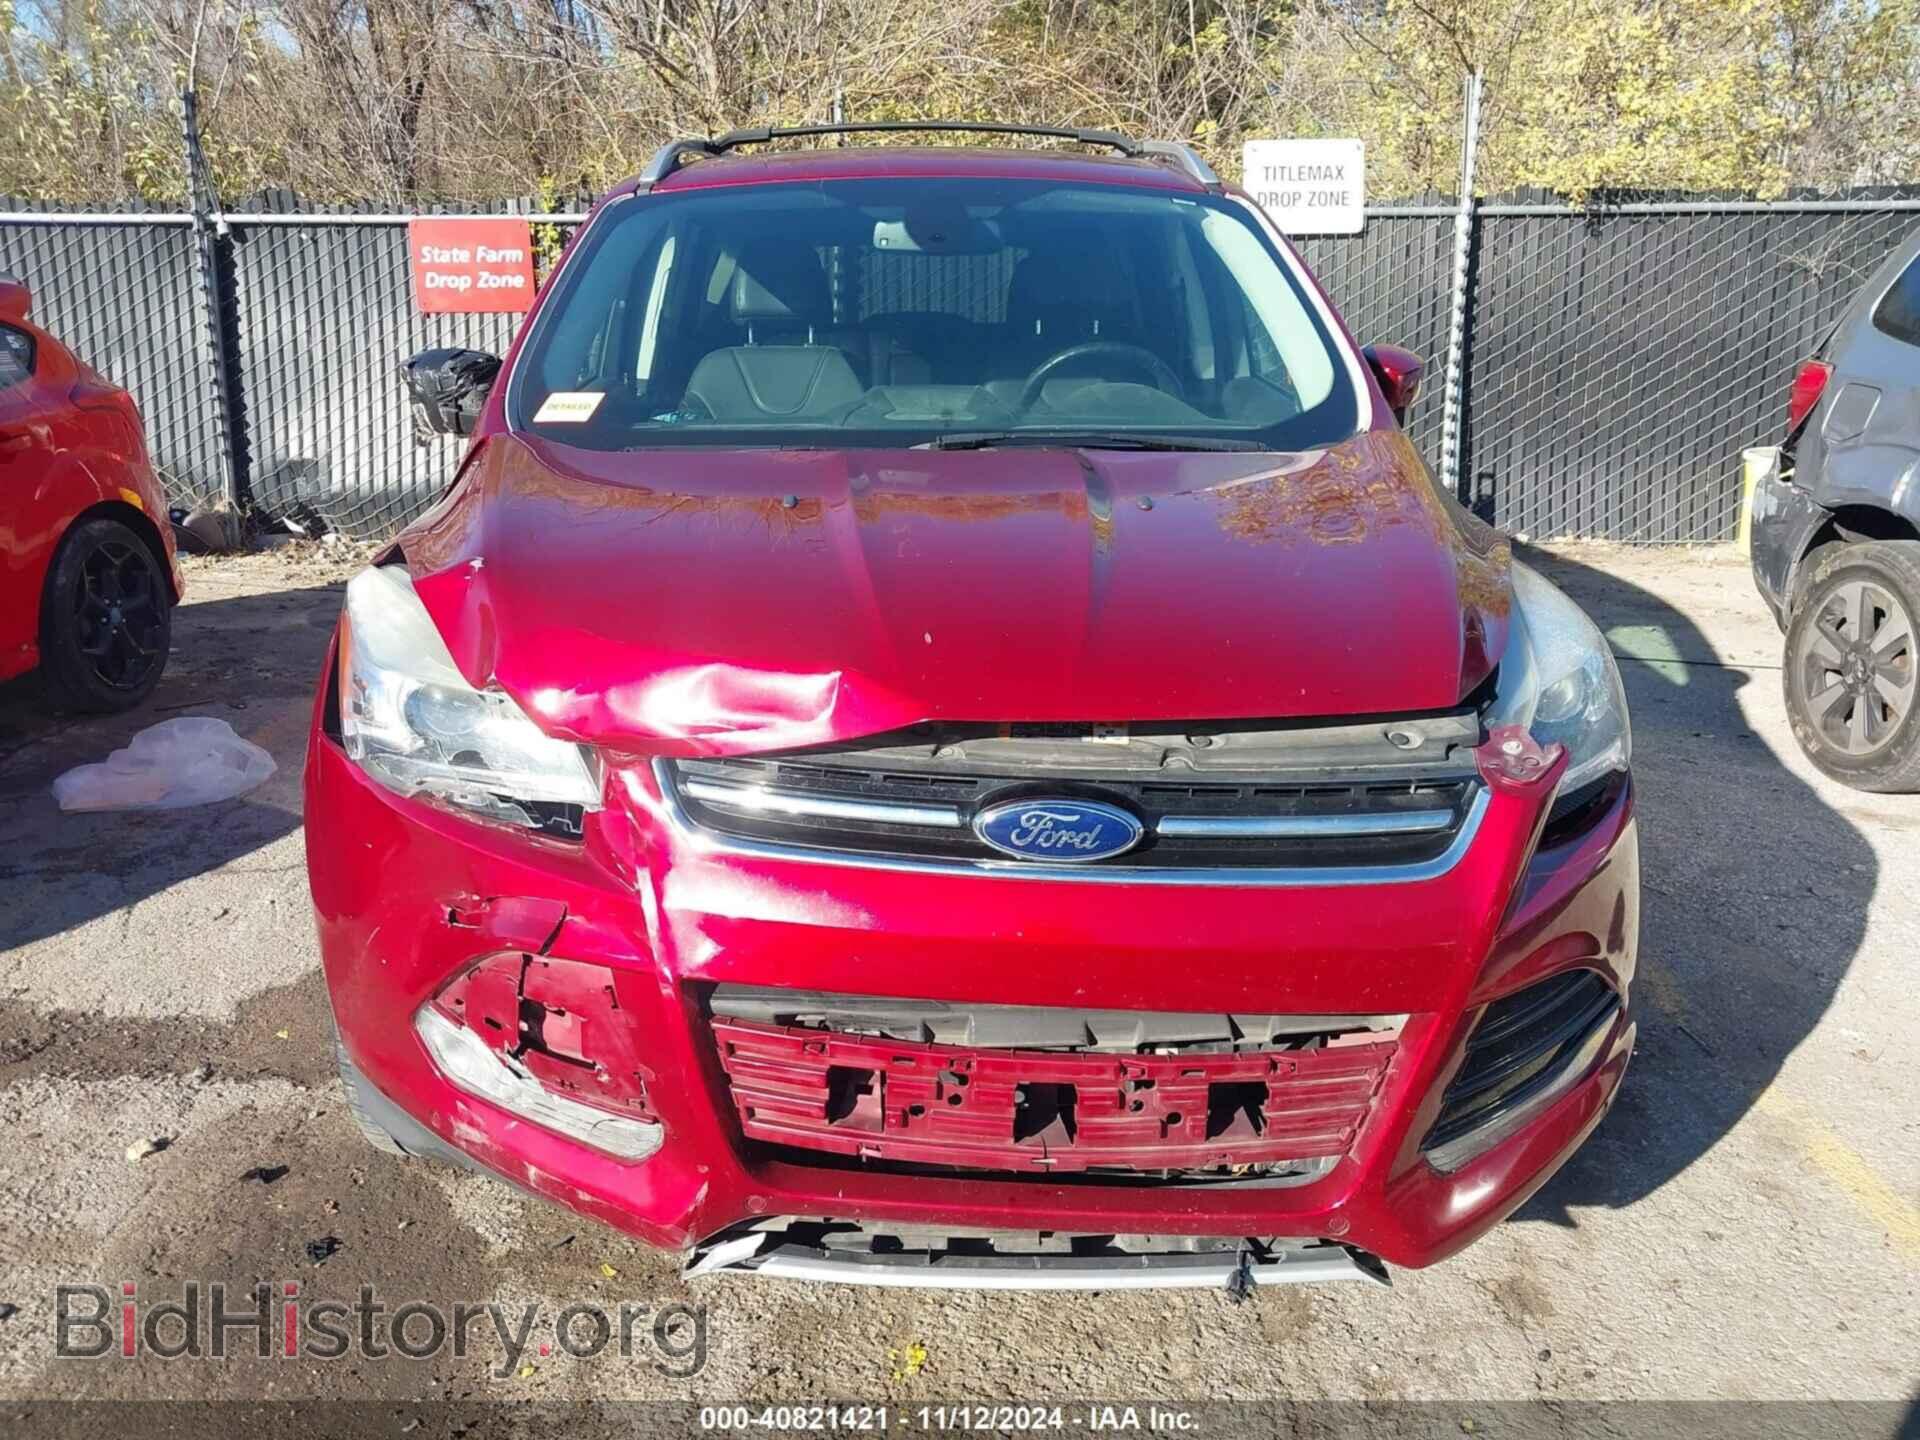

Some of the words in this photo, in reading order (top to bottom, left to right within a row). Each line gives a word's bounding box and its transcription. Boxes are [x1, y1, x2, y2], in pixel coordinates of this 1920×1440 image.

[1263, 165, 1345, 182] TITLEMAX
[1257, 191, 1302, 208] DROP
[1307, 191, 1351, 207] ZONE
[420, 245, 470, 263] State
[476, 245, 523, 263] Farm
[425, 271, 472, 292] Drop
[477, 271, 525, 288] Zone
[1010, 811, 1103, 850] Ford
